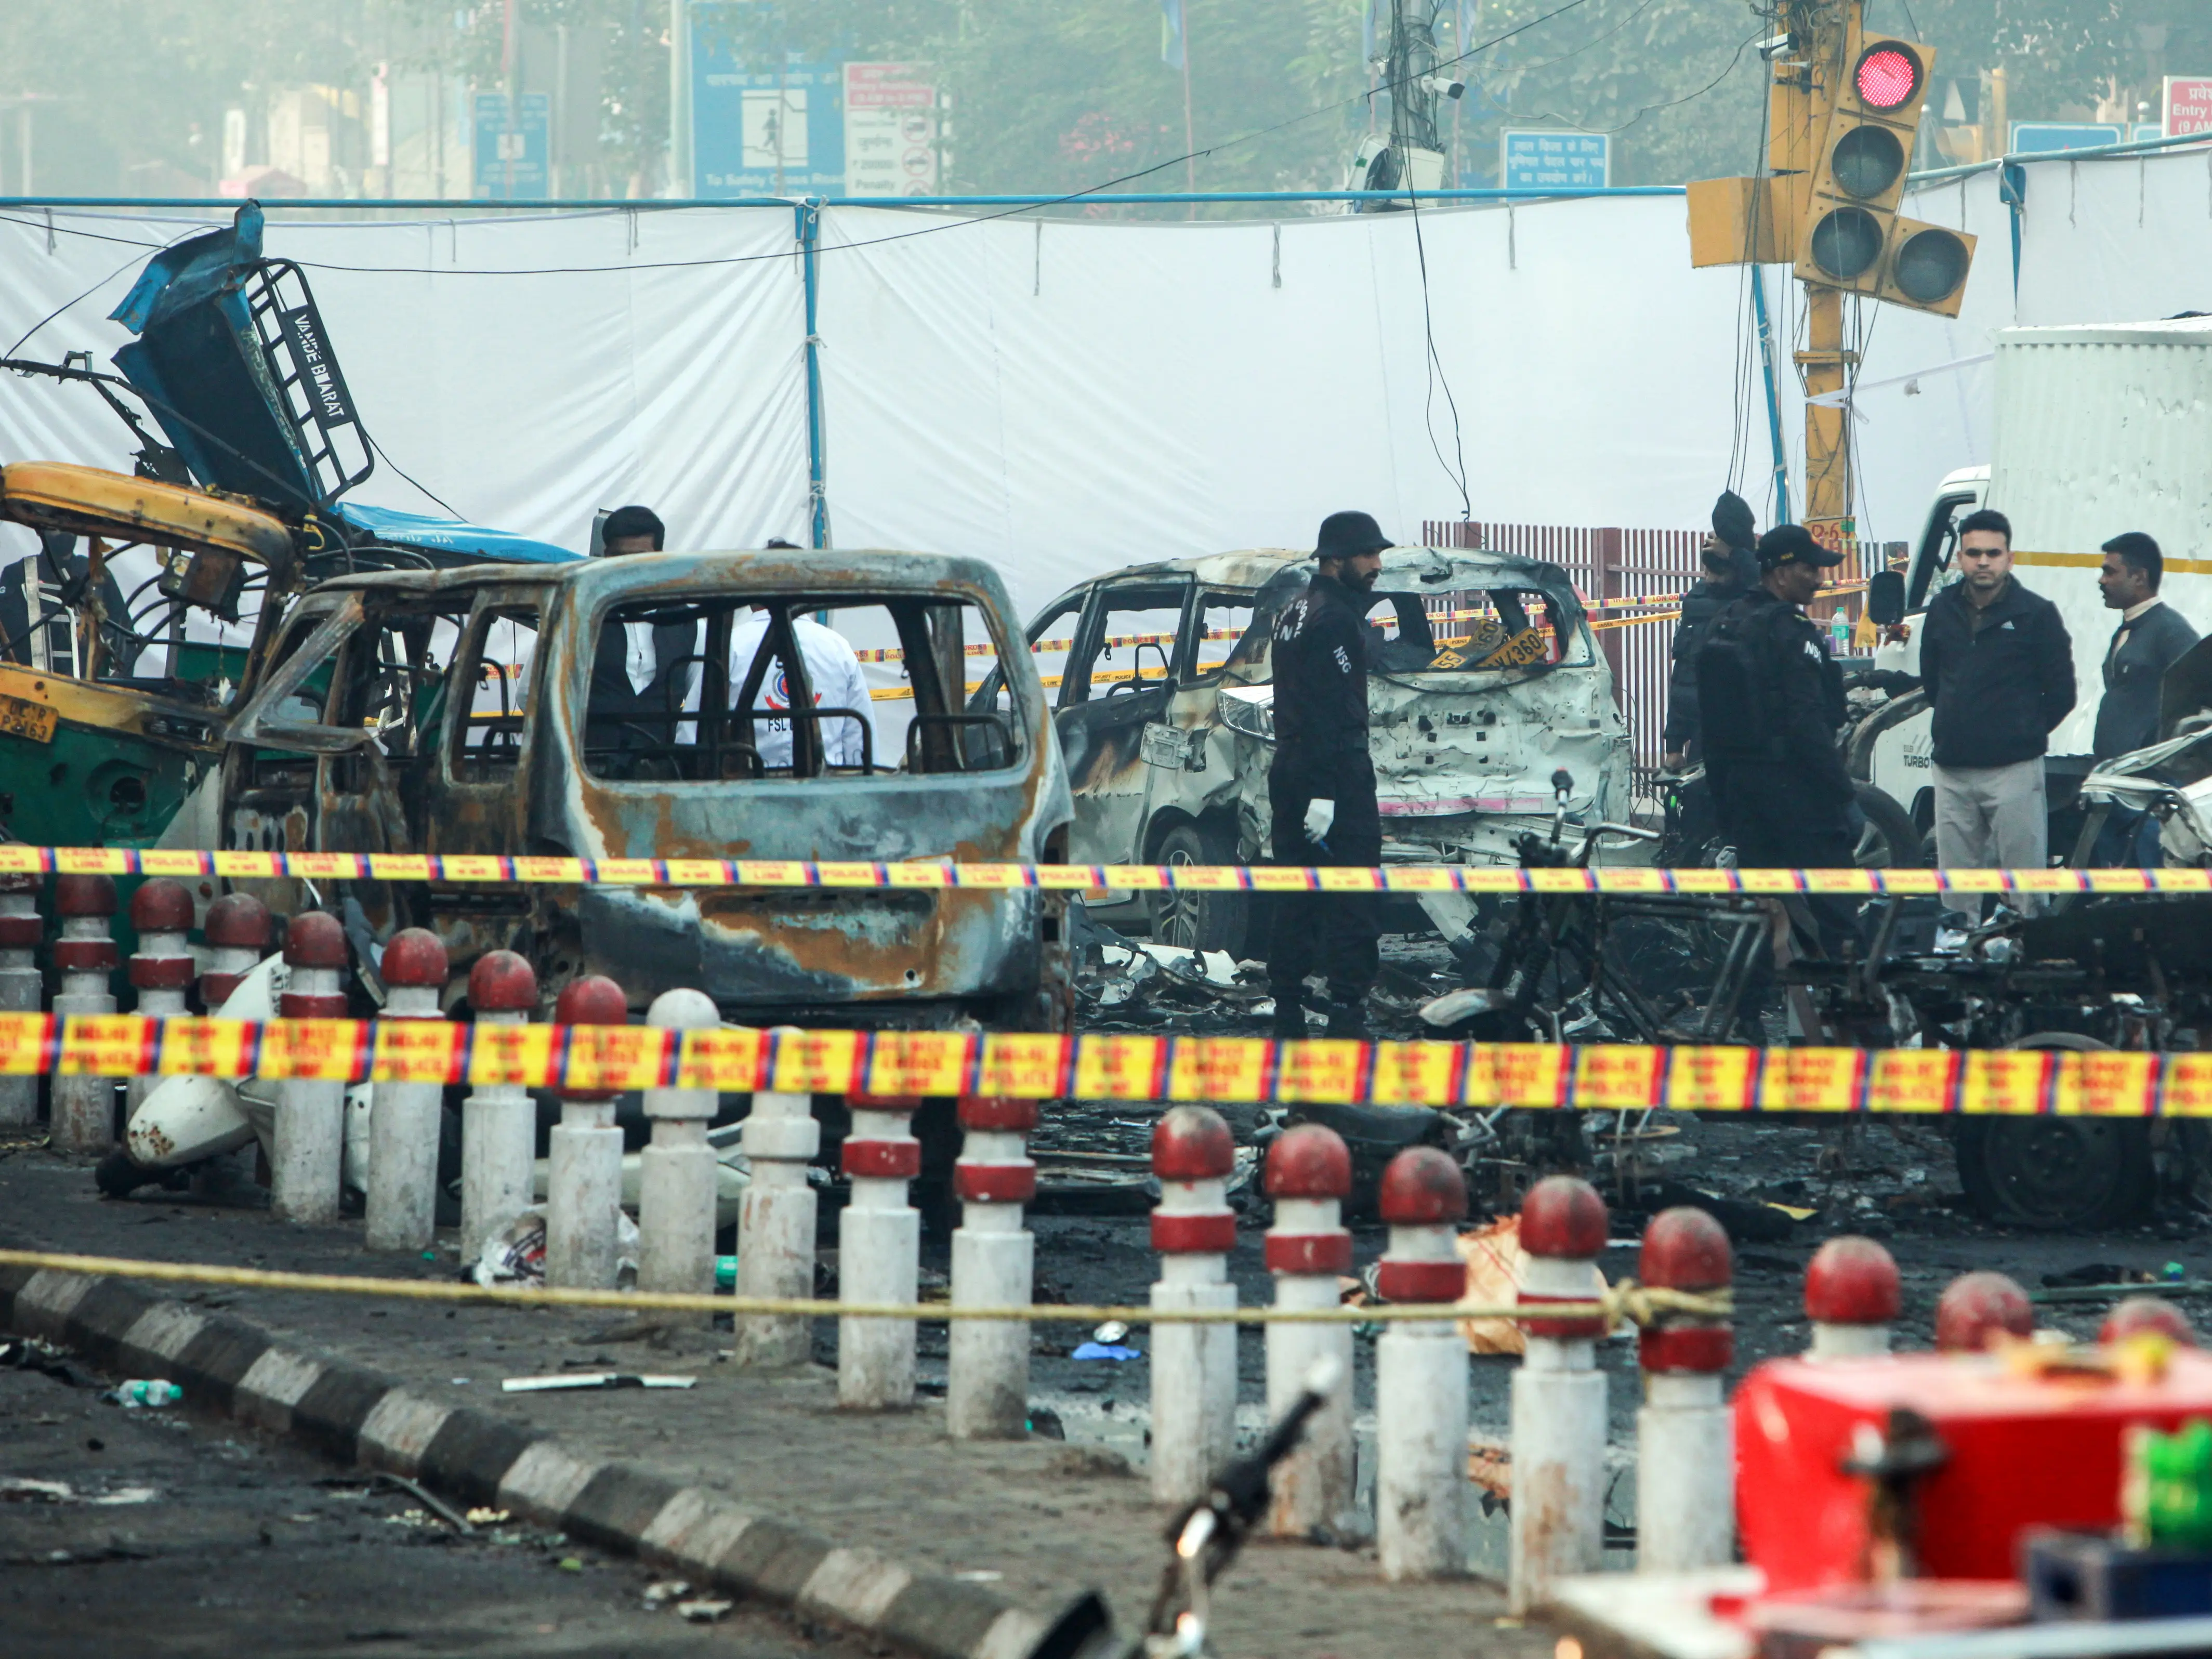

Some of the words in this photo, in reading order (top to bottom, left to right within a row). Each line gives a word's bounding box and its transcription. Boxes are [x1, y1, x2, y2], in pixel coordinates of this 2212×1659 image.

[2173, 103, 2207, 120] Entry
[1333, 646, 1351, 673] NSG
[768, 719, 786, 732] FSL
[1903, 755, 1930, 768] TURBO
